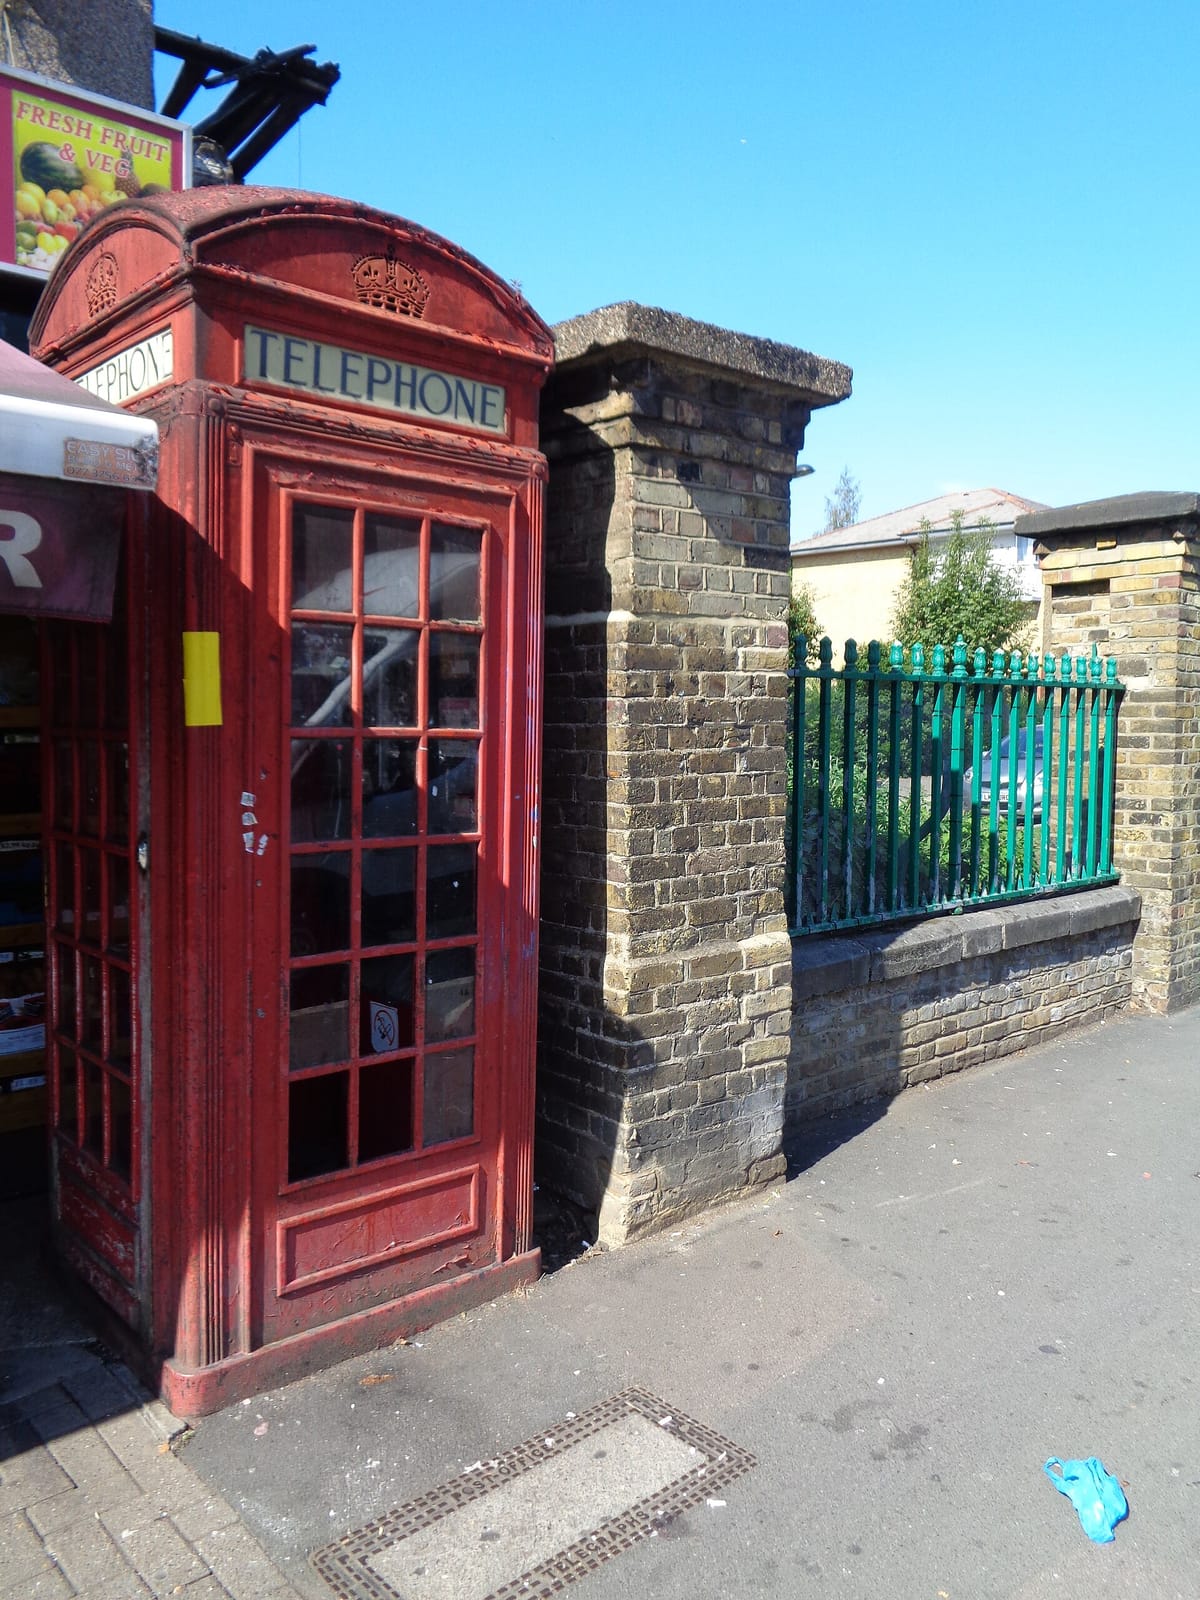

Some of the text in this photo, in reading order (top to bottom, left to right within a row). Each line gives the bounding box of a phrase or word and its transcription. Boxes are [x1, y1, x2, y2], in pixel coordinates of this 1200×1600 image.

[15, 100, 169, 163] FRESH FRUIT
[58, 142, 131, 178] & VEG
[76, 331, 172, 402] EPHONE
[251, 329, 500, 428] TELEPHONE
[66, 441, 111, 457] EASY
[541, 1509, 650, 1580] TELEGRAPHS
